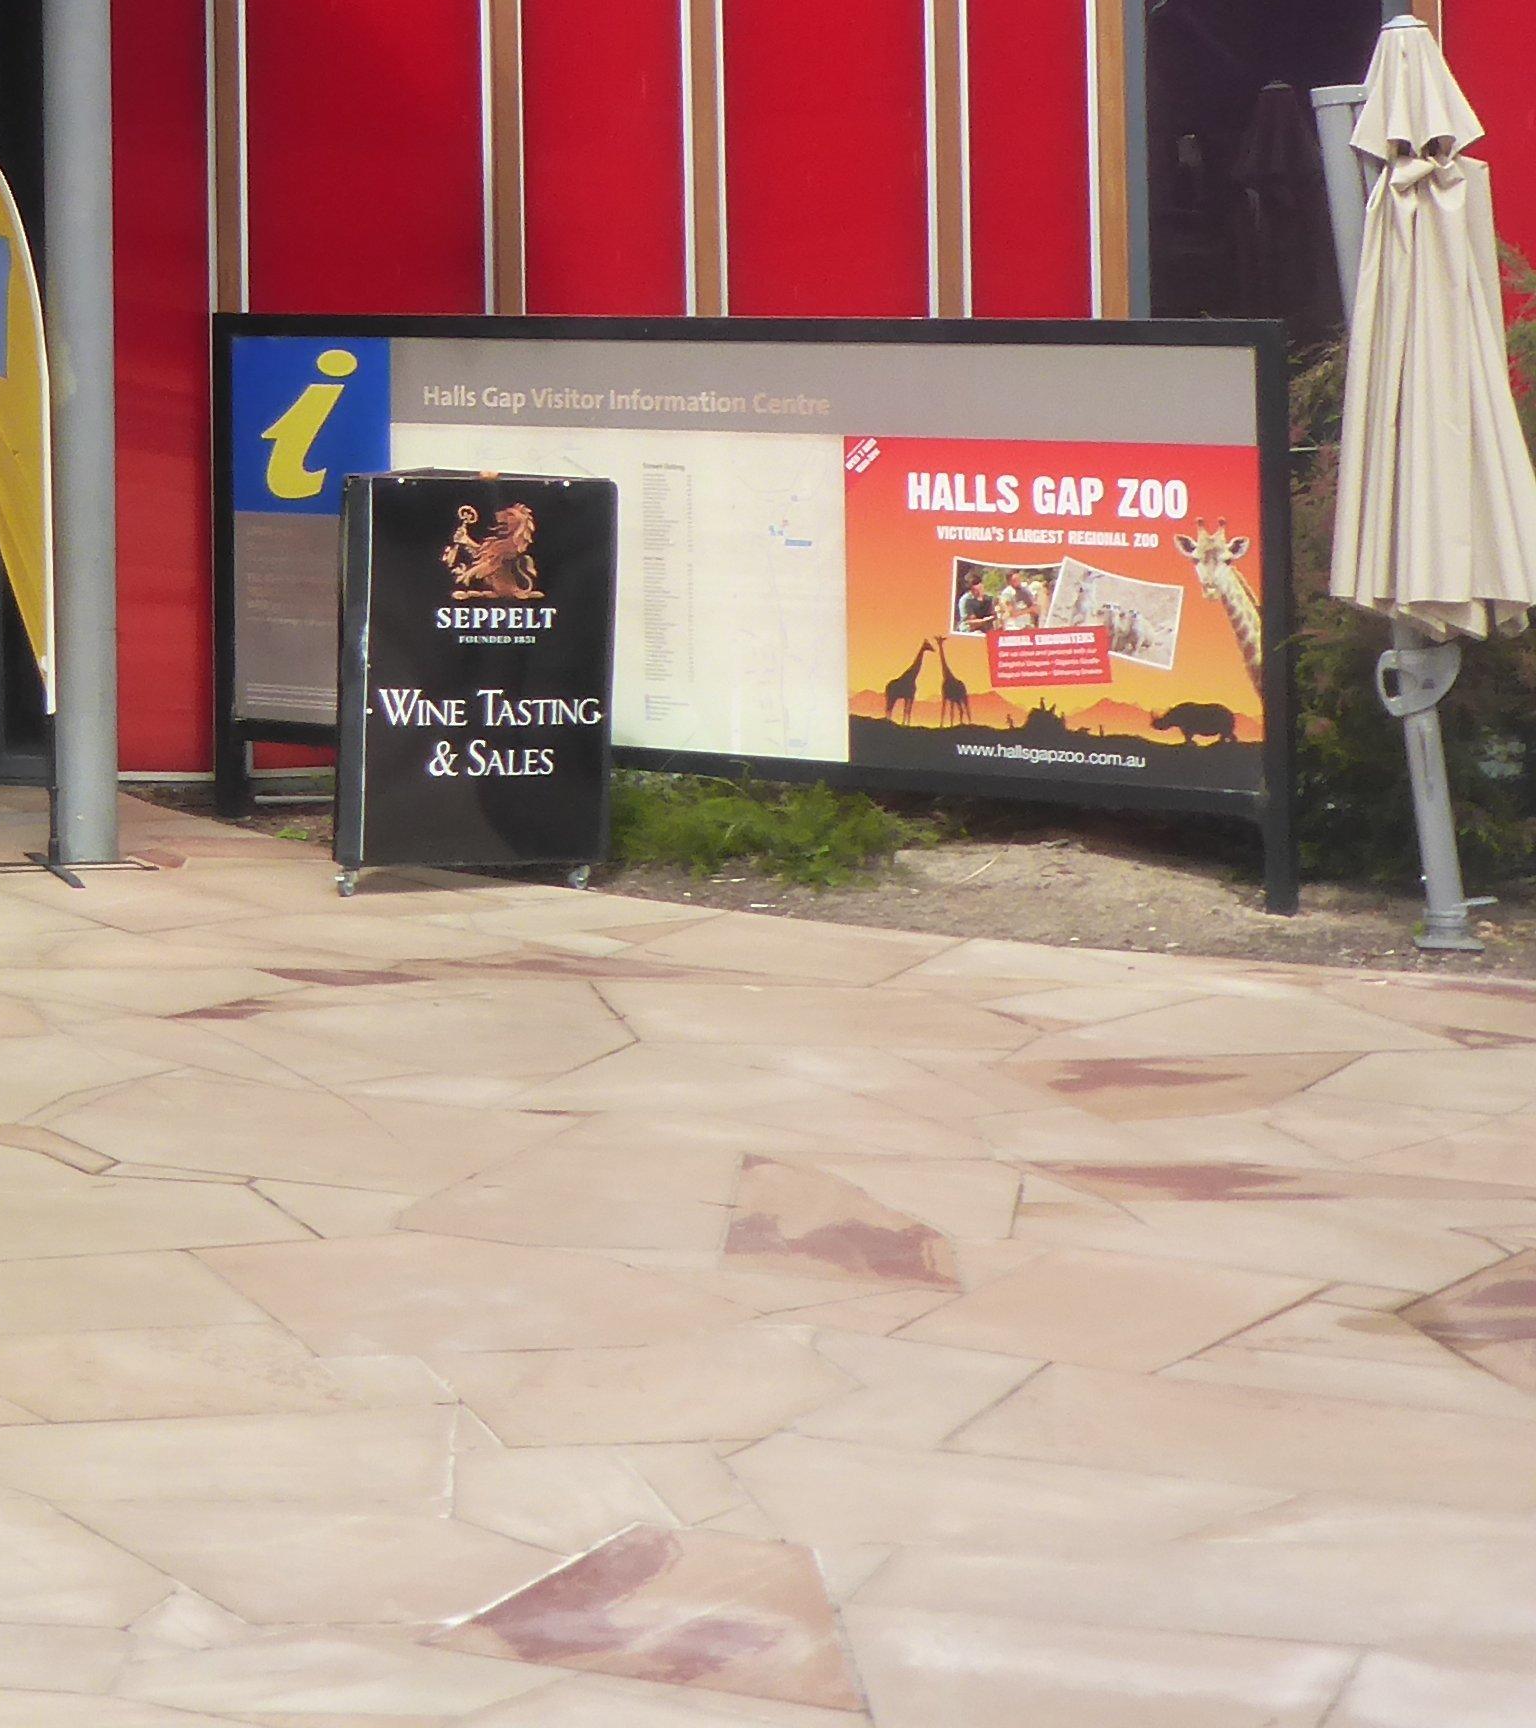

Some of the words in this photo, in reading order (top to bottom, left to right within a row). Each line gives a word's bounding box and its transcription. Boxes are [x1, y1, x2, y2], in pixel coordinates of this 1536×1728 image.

[423, 385, 476, 408] Halls
[481, 387, 526, 415] Gap
[531, 387, 604, 411] Visitor
[609, 388, 746, 414] Information
[752, 392, 830, 417] Centre
[906, 471, 1020, 514] HALLS
[1032, 475, 1105, 517] GAP
[1117, 478, 1189, 520] ZOO
[936, 525, 1005, 542] VICTORIA'S
[1008, 527, 1064, 544] LARGEST
[1068, 530, 1130, 547] REGIONAL
[1133, 532, 1159, 548] ZOO
[436, 607, 557, 630] SEPPELT
[458, 635, 512, 645] FOUNDED
[514, 635, 536, 645] 1851
[378, 688, 469, 727] WINE
[476, 689, 604, 727] TASTING
[429, 740, 459, 778] &
[467, 739, 555, 777] SALES
[956, 743, 1147, 769] www.hallsgapzoo.com.au
